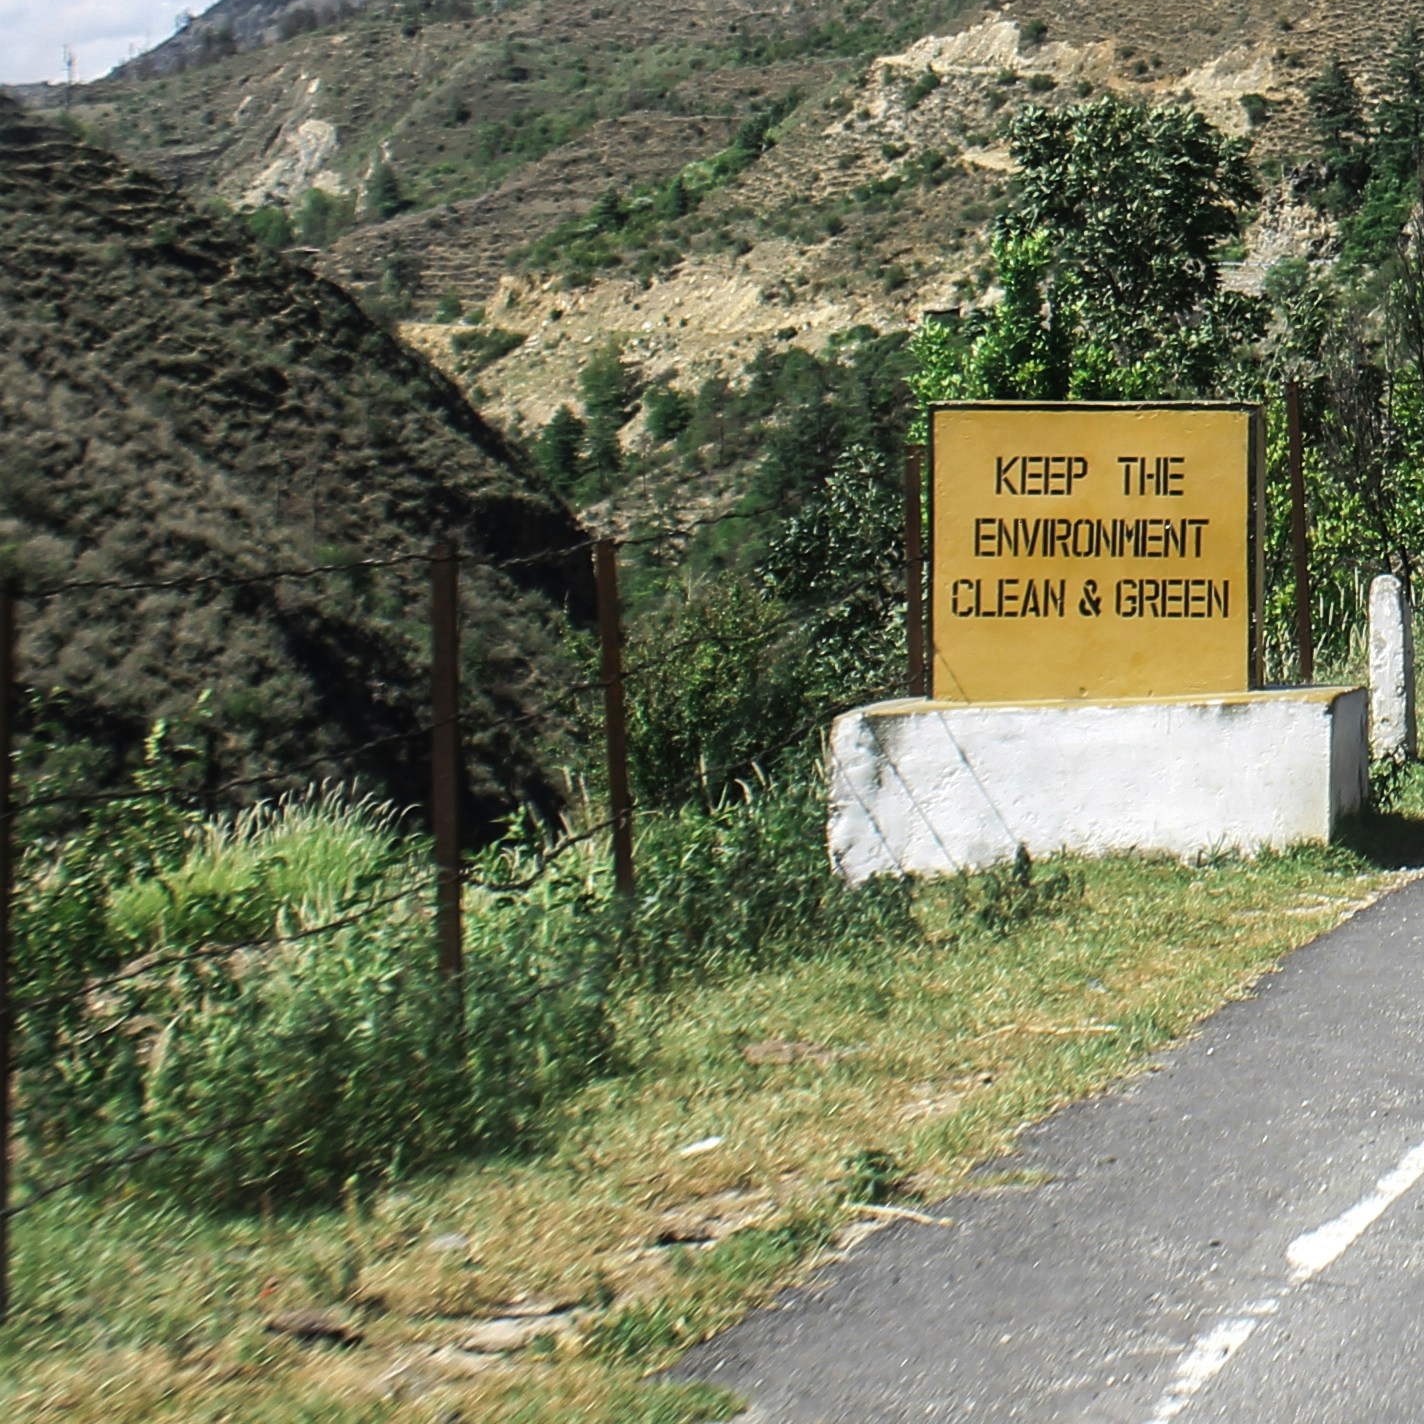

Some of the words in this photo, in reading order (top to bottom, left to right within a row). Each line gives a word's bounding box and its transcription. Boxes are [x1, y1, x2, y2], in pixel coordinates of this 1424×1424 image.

[995, 456, 1088, 496] KEEP
[1117, 456, 1185, 496] THE
[974, 518, 1210, 558] ENVIRONMENT
[952, 578, 1066, 618] CLEAN
[1079, 579, 1102, 618] &
[1115, 579, 1230, 618] GREEN
